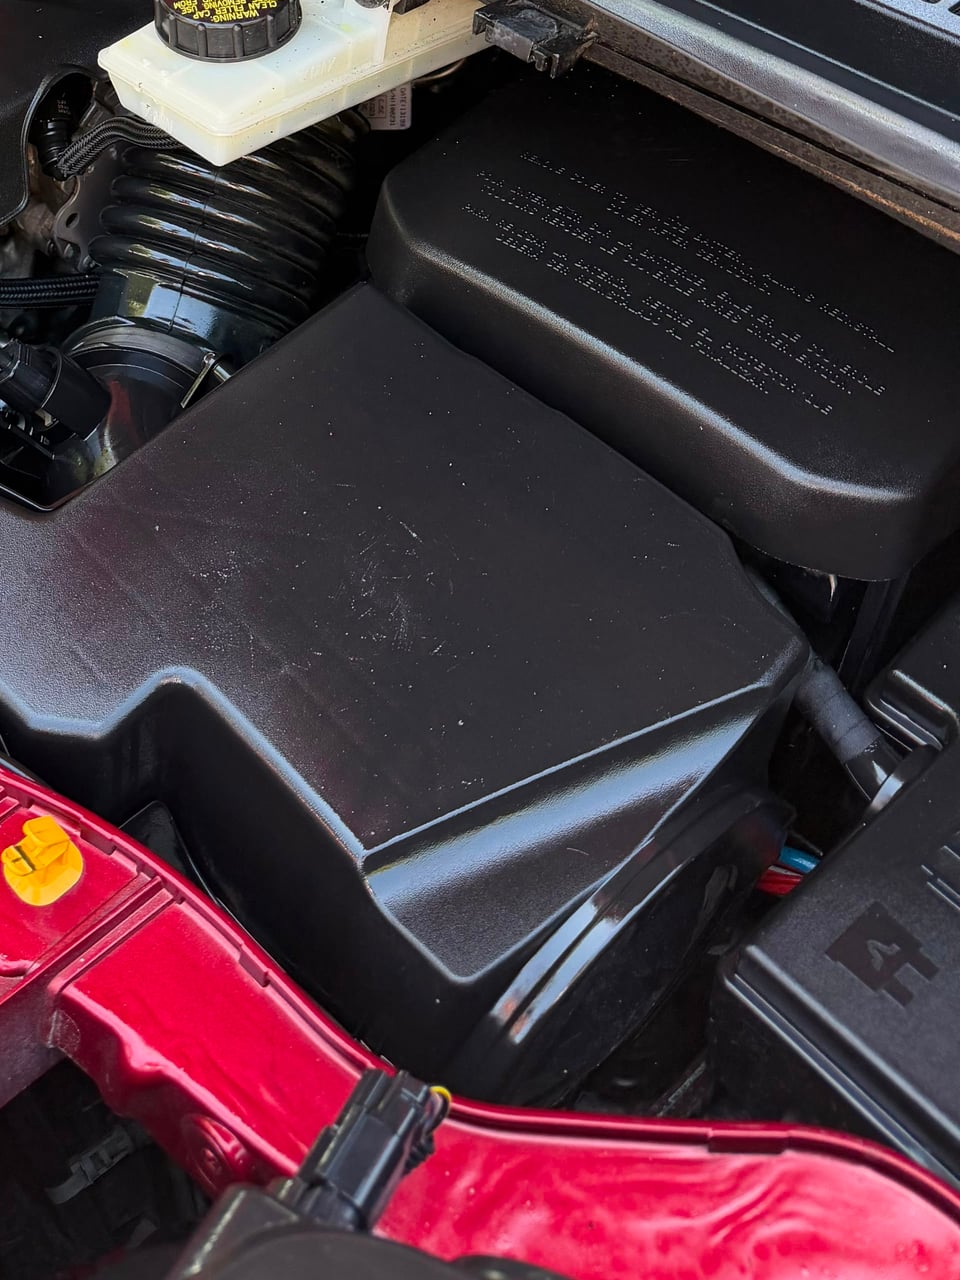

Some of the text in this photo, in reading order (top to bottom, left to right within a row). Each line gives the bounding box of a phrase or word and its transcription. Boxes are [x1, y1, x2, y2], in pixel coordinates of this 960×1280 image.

[174, 0, 197, 8] FROM
[193, 1, 277, 19] CLEAN FILLER CAP
[210, 10, 259, 22] WARNING:
